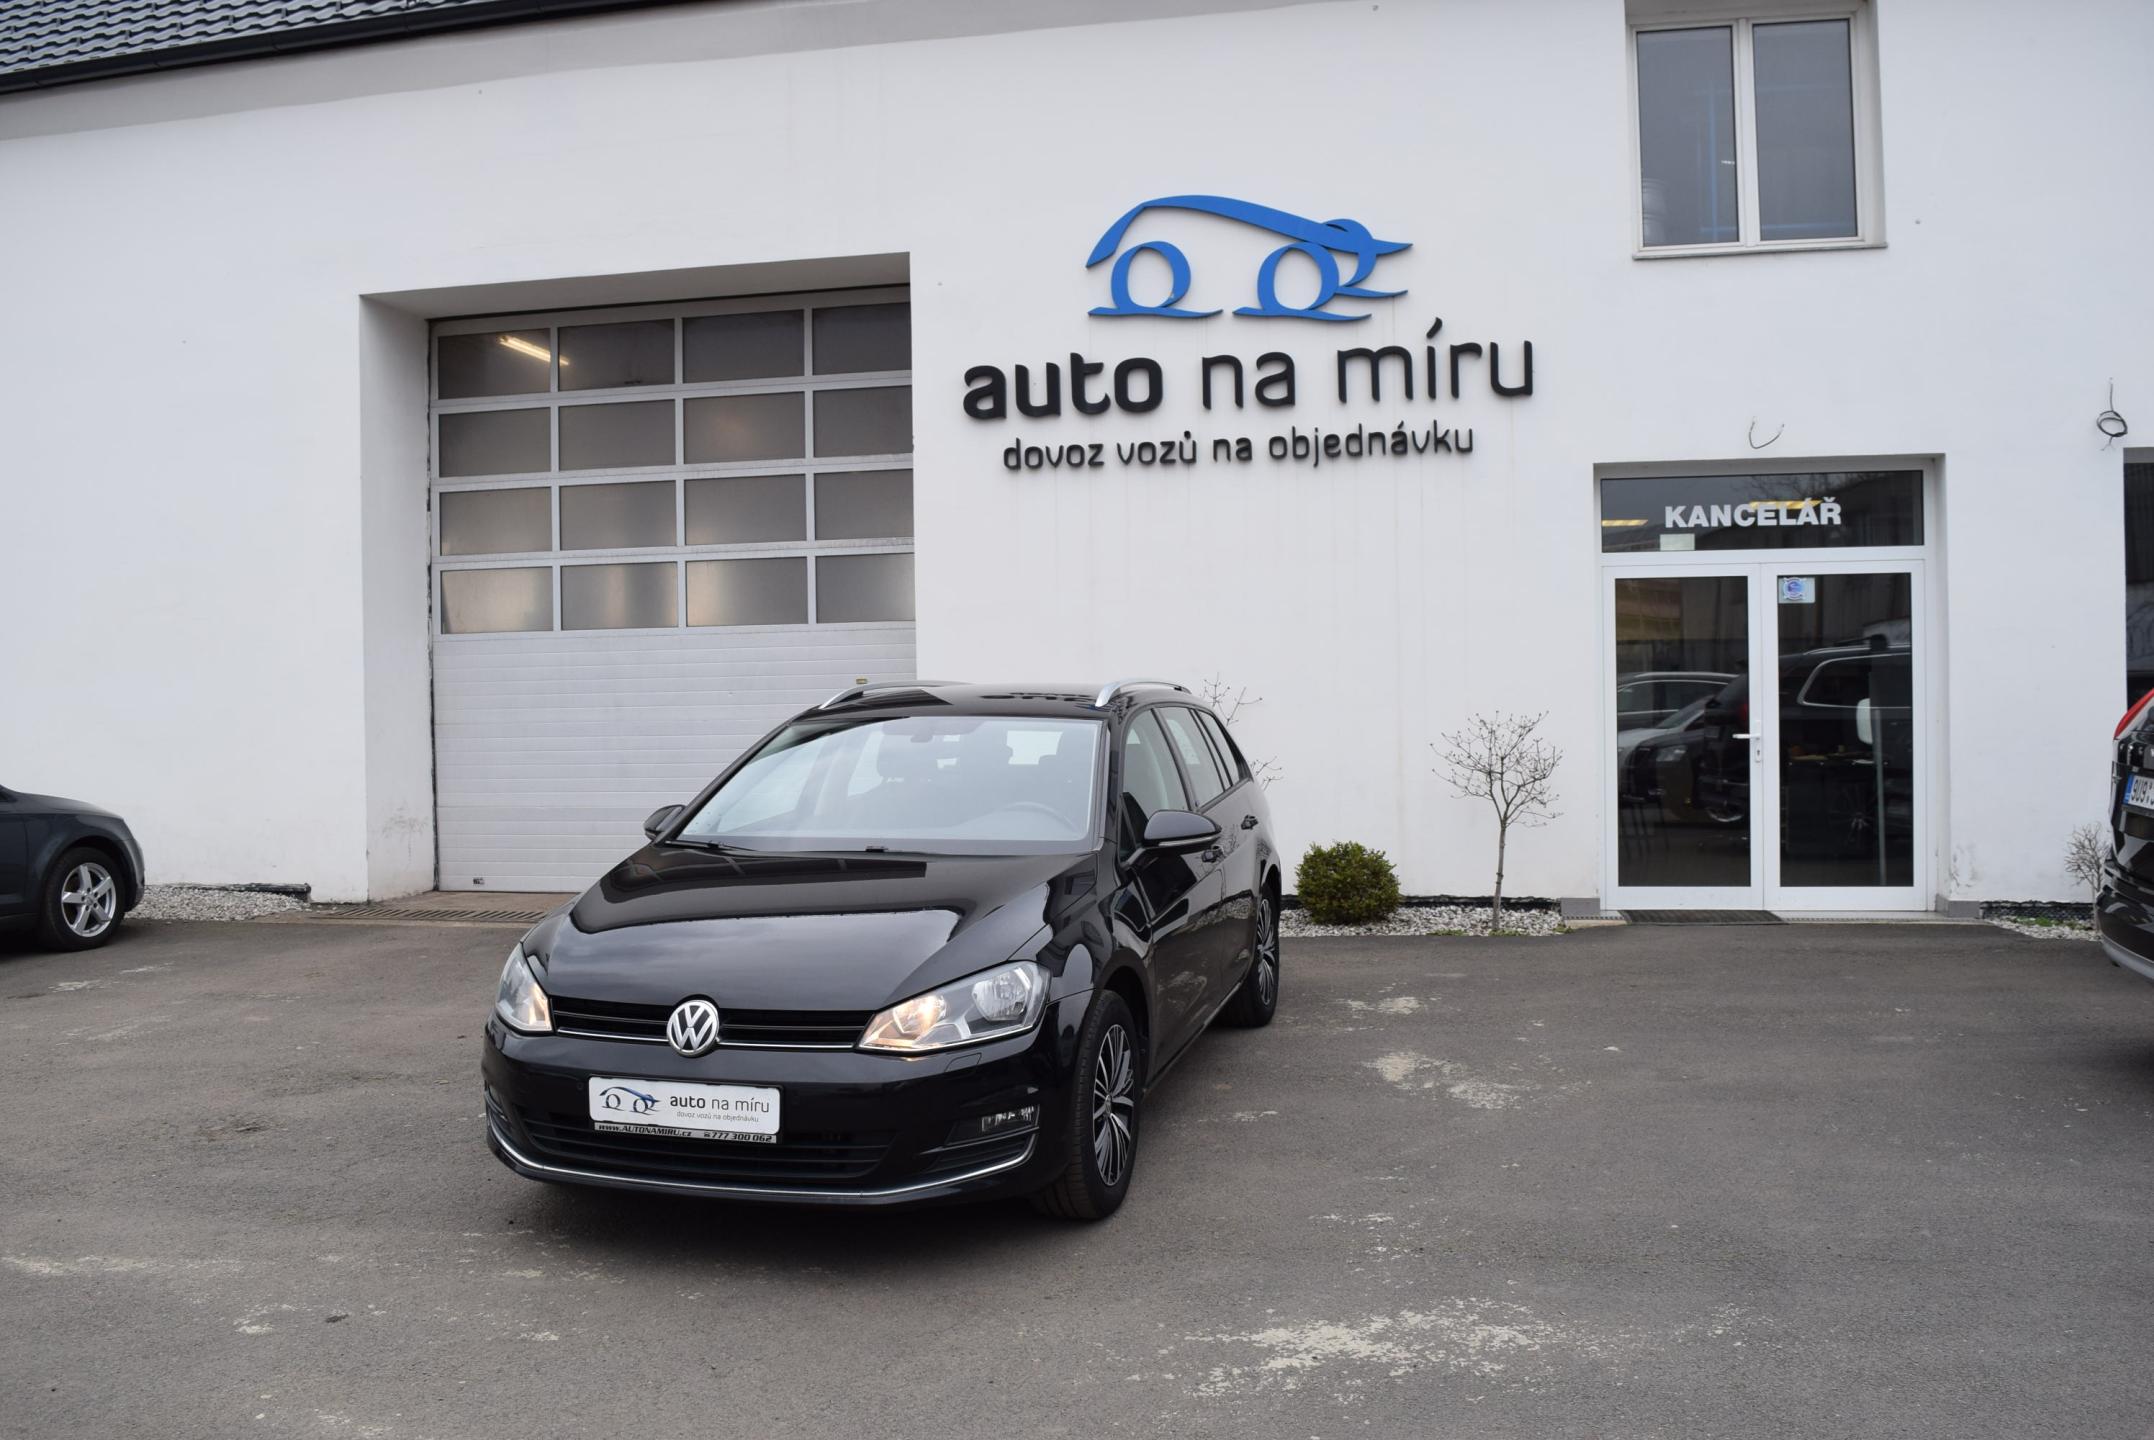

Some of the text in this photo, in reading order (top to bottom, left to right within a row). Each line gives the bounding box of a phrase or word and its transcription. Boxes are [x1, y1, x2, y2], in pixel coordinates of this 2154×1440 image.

[963, 317, 1534, 422] auto na míru
[1003, 420, 1475, 471] dovoz vozů na objednávku
[1665, 497, 1842, 528] KANCELÁŘ
[669, 1095, 770, 1113] auto na míru
[676, 1110, 696, 1118] dovoz
[711, 1131, 729, 1140] 777
[732, 1132, 751, 1142] 300
